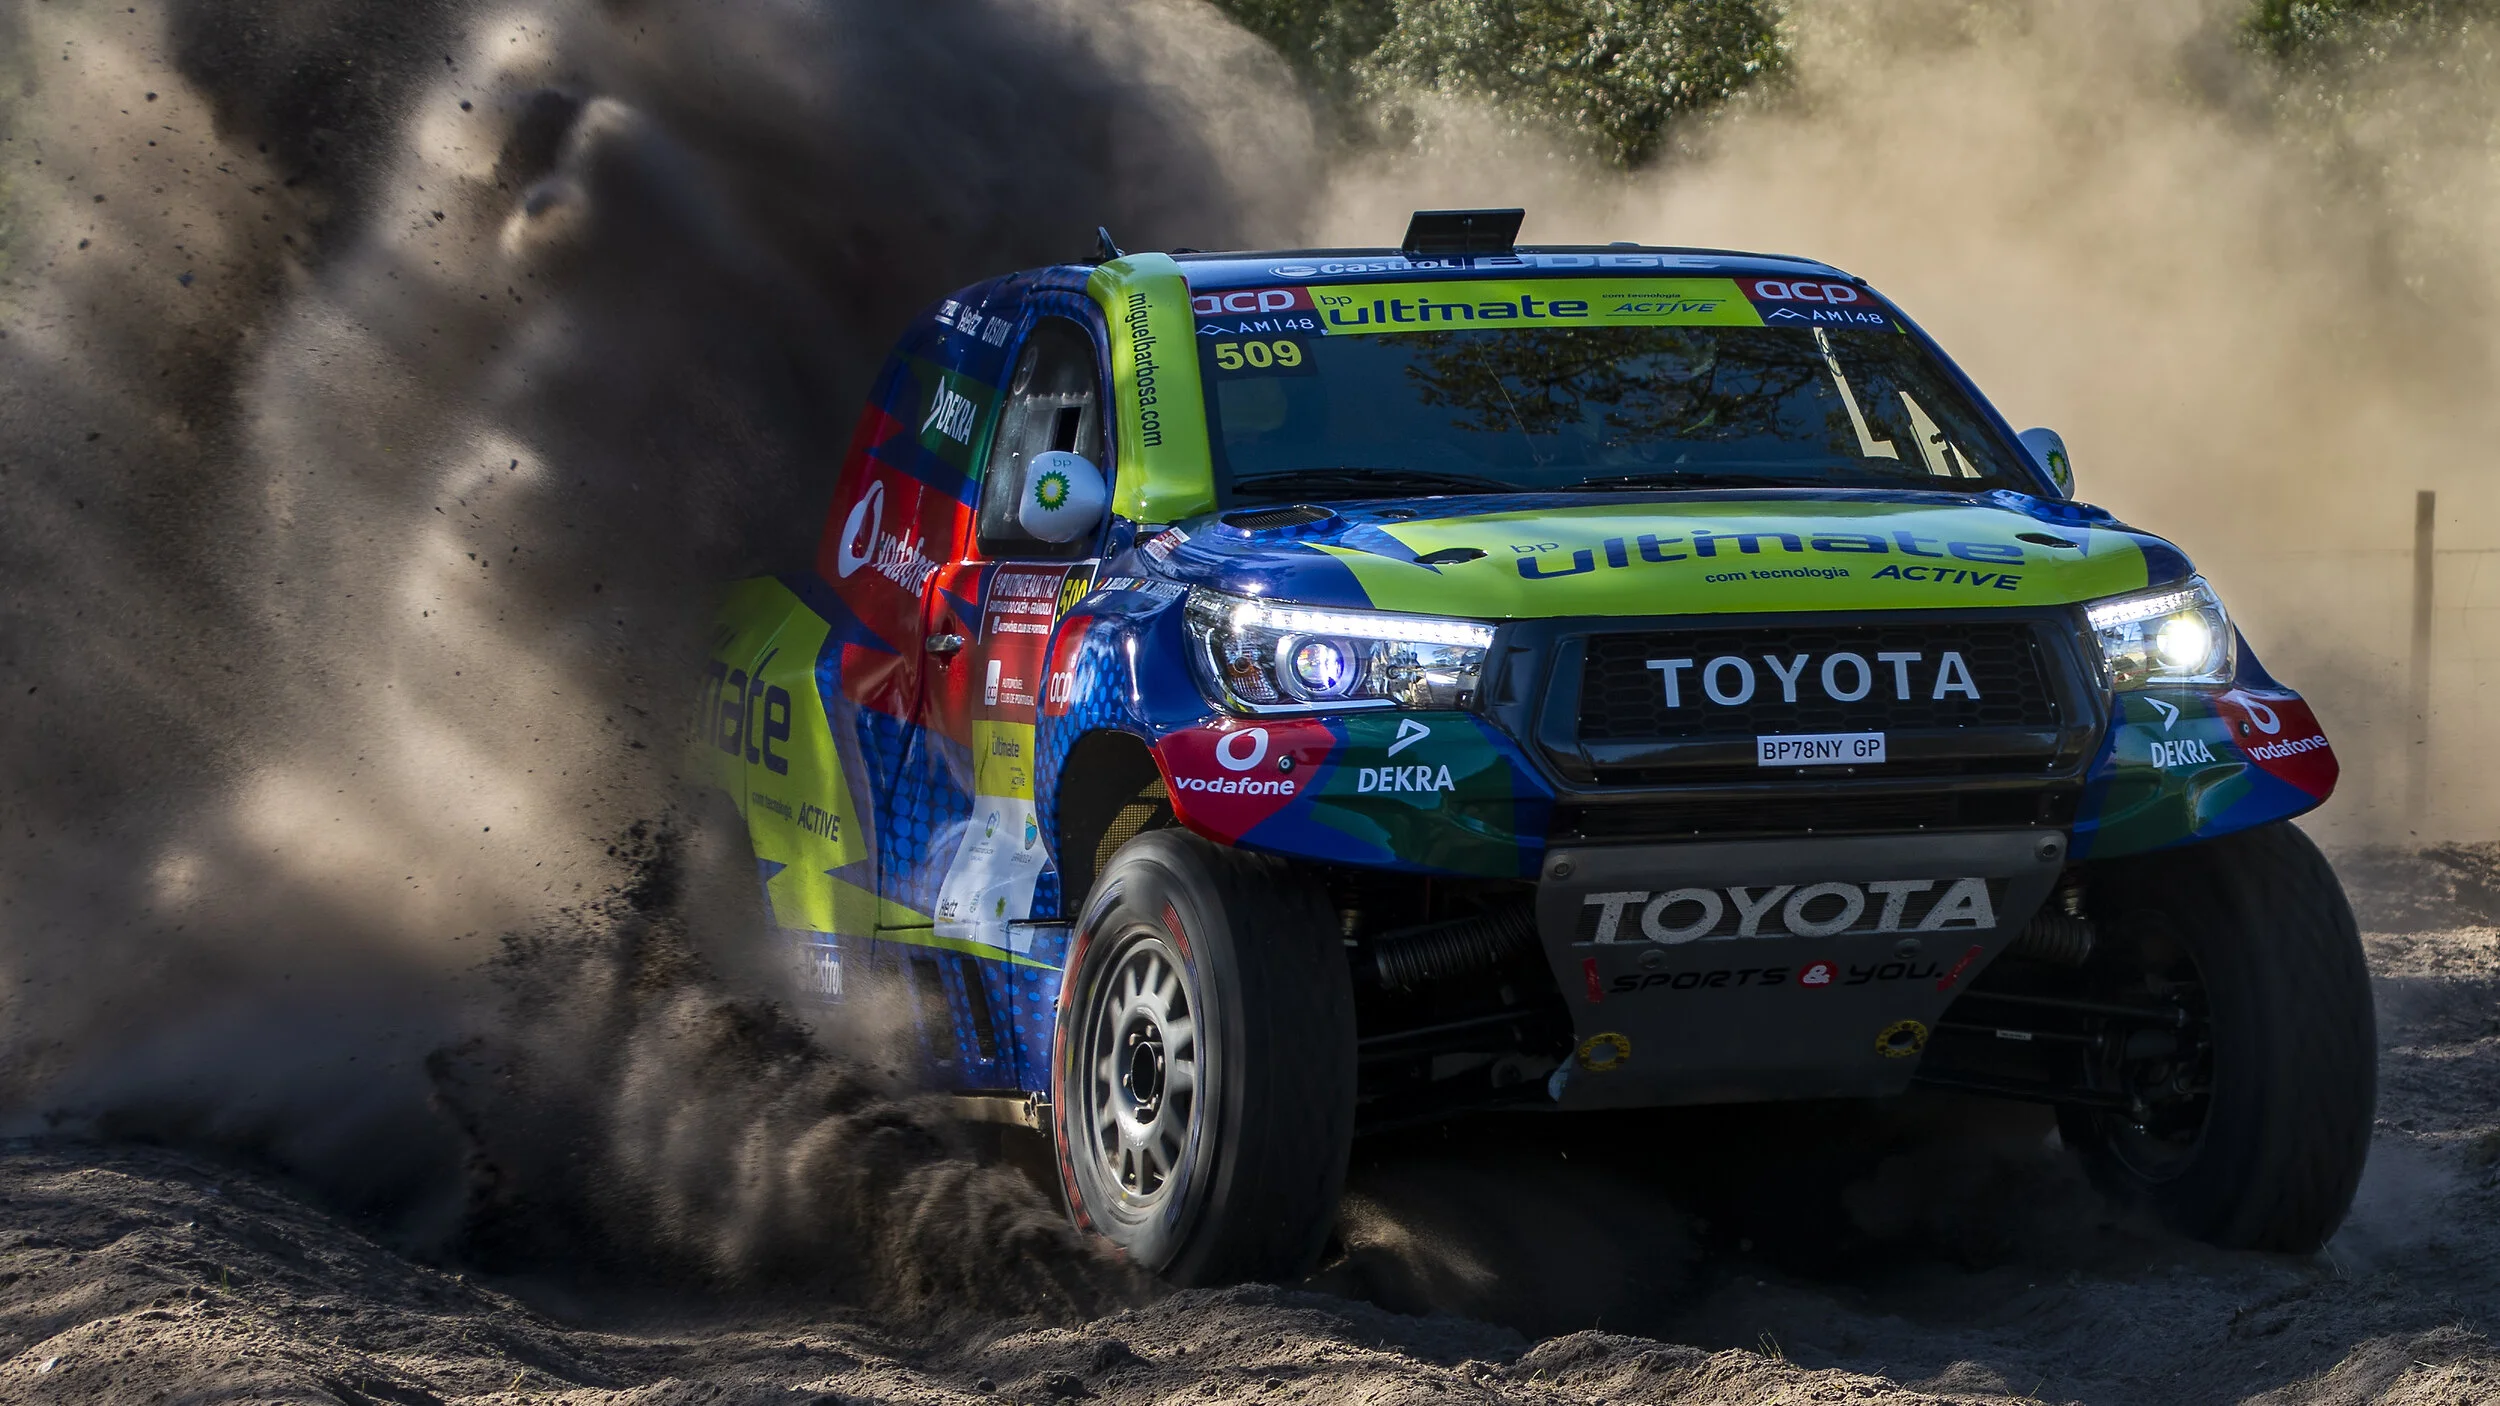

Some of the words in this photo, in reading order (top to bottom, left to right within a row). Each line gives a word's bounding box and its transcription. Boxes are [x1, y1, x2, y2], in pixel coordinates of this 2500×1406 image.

[1319, 257, 1457, 275] Castrol
[1474, 254, 1720, 270] EDGE
[1192, 289, 1296, 315] acp
[1320, 295, 1353, 307] bp
[1627, 292, 1681, 300] tecnologia
[1755, 280, 1859, 304] acp
[1329, 295, 1589, 326] ultimate
[1614, 302, 1718, 313] ACTIVE
[1215, 340, 1303, 370] 509
[1125, 292, 1163, 448] miguelbarbosa.com
[936, 389, 978, 446] DEKRA
[1052, 458, 1072, 468] bp
[1509, 541, 1560, 553] bp
[1516, 529, 2027, 581] ultimate
[1704, 571, 1747, 584] com
[1750, 565, 1850, 582] tecnologia
[1871, 564, 2023, 592] ACTIVE
[1050, 672, 1073, 708] acp
[1645, 651, 1981, 708] TOYOTA
[1763, 739, 1842, 761] BP78NY
[1853, 738, 1881, 758] GP
[2150, 738, 2217, 769] DEKRA
[2247, 734, 2330, 761] vodafone
[1175, 776, 1295, 795] vodafone
[1357, 764, 1456, 793] DEKRA
[797, 802, 841, 843] ACTIVE
[1583, 877, 1997, 945] TOYOTA
[1609, 966, 1791, 993] SPORTS
[1800, 963, 1834, 986] &
